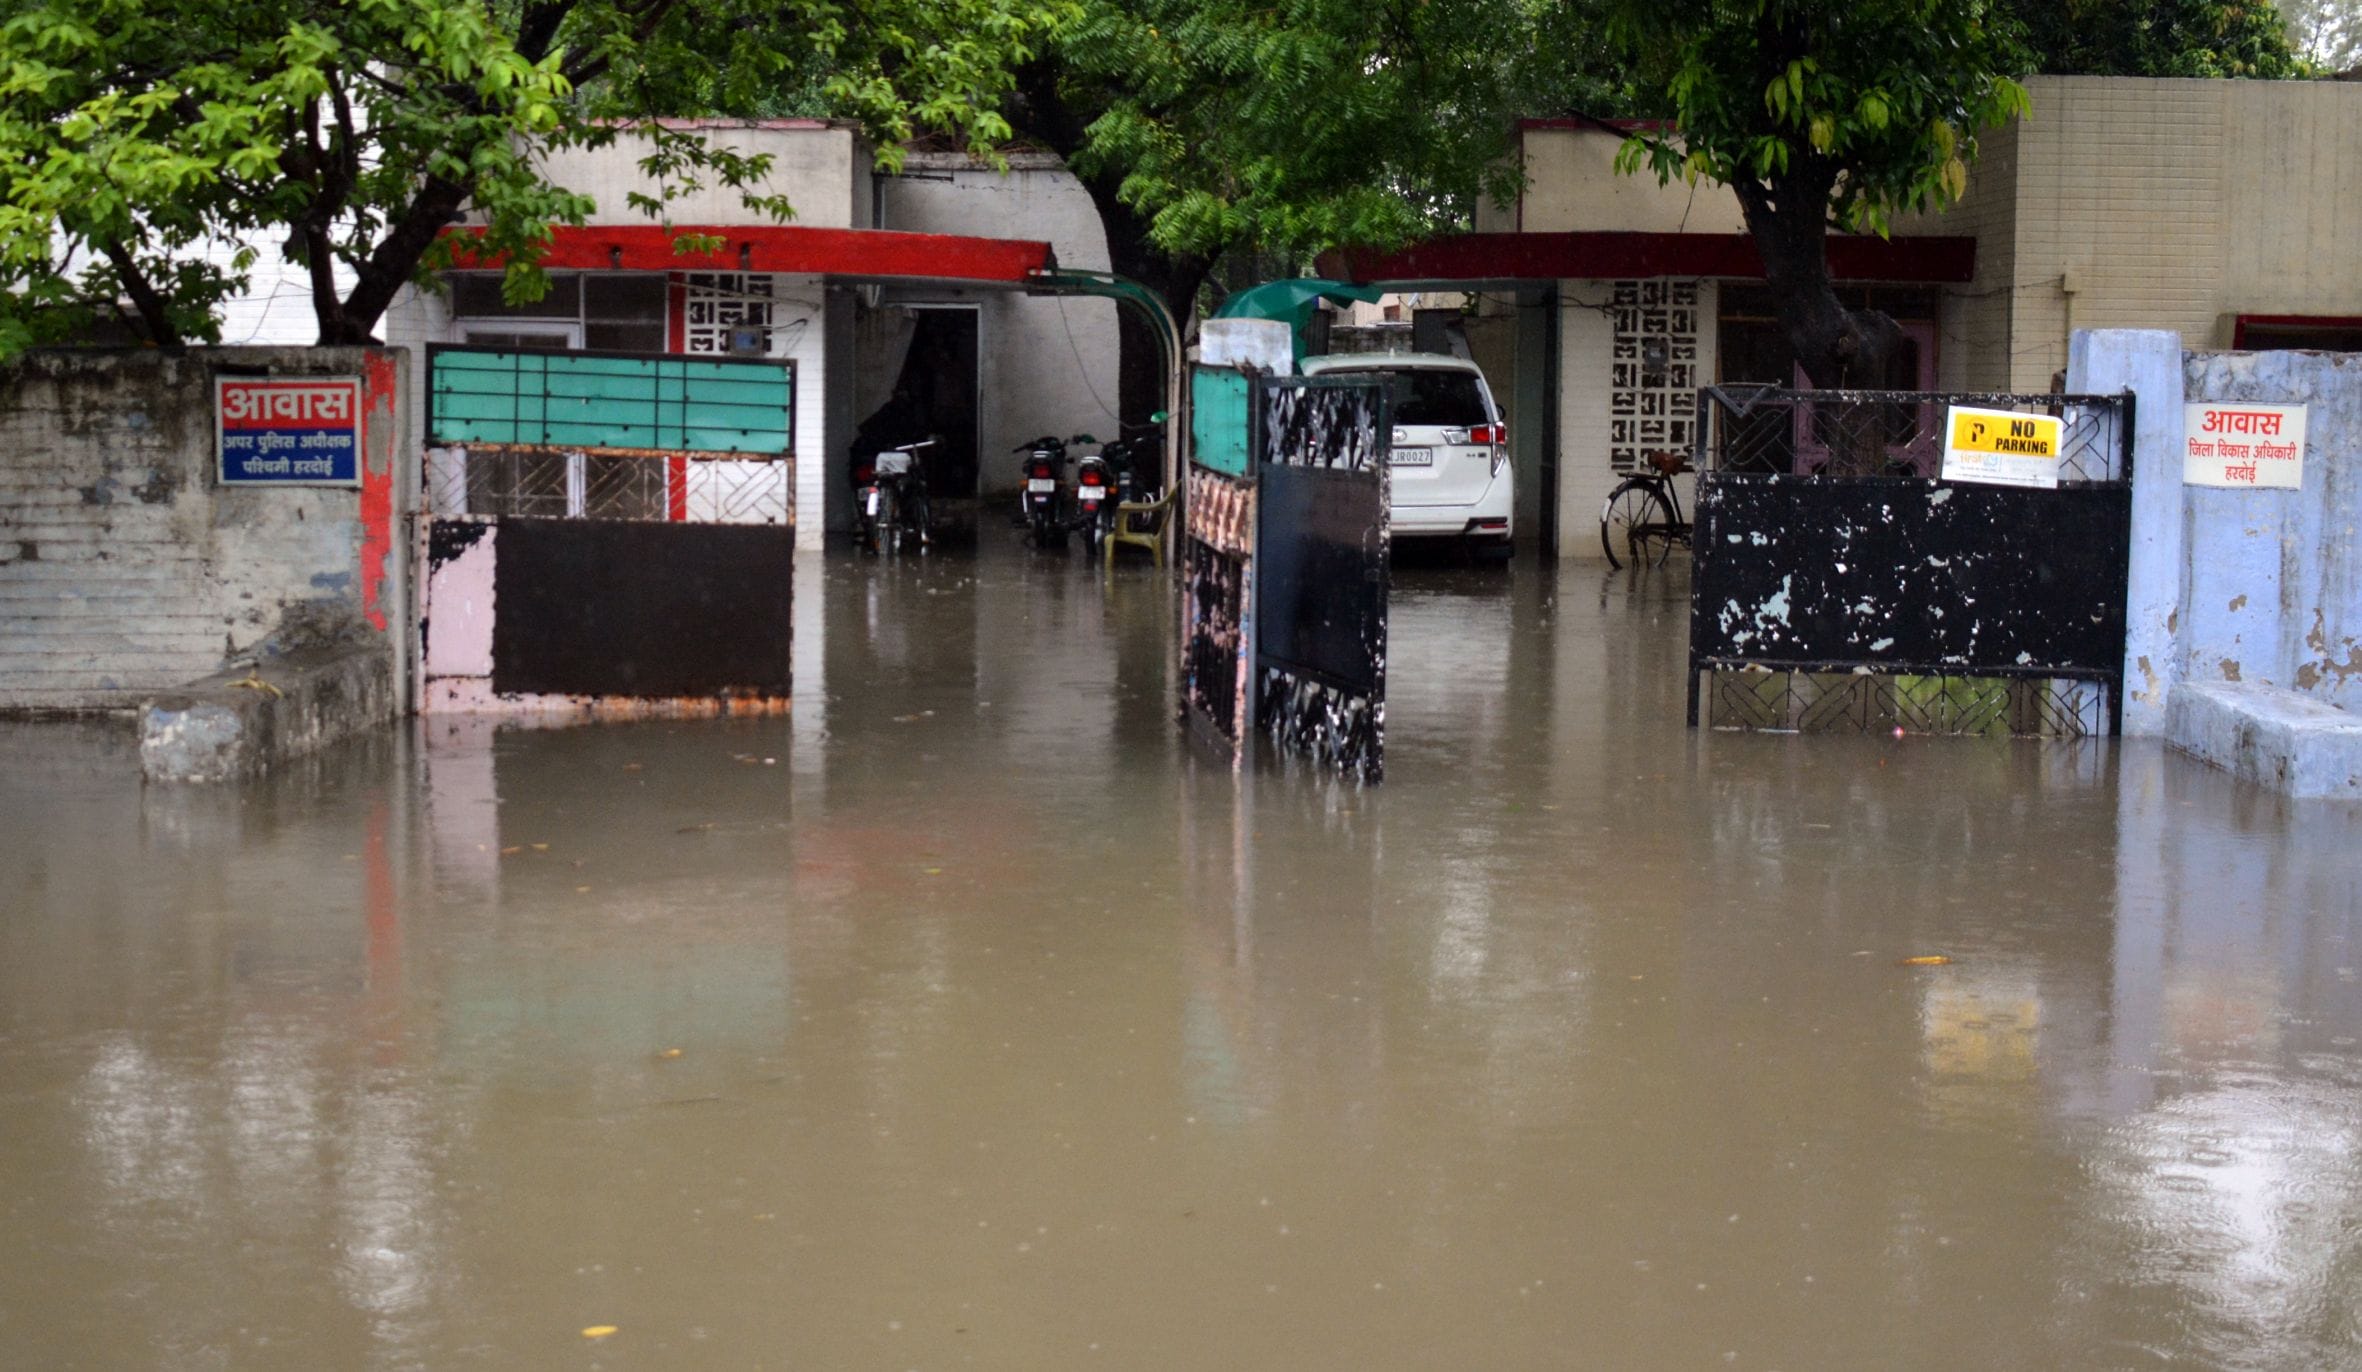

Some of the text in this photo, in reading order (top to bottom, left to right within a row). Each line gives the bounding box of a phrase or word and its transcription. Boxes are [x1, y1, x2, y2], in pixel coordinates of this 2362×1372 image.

[223, 388, 352, 420] आवास
[2010, 419, 2035, 438] NO
[2202, 410, 2283, 436] आवास
[223, 430, 352, 454] अपर पुलिस अधीक्षक
[1995, 437, 2048, 455] PARKING
[2188, 437, 2297, 460] जिला विकास अधिकारी
[293, 454, 334, 477] हरदोई
[2225, 461, 2257, 484] हरदोई
